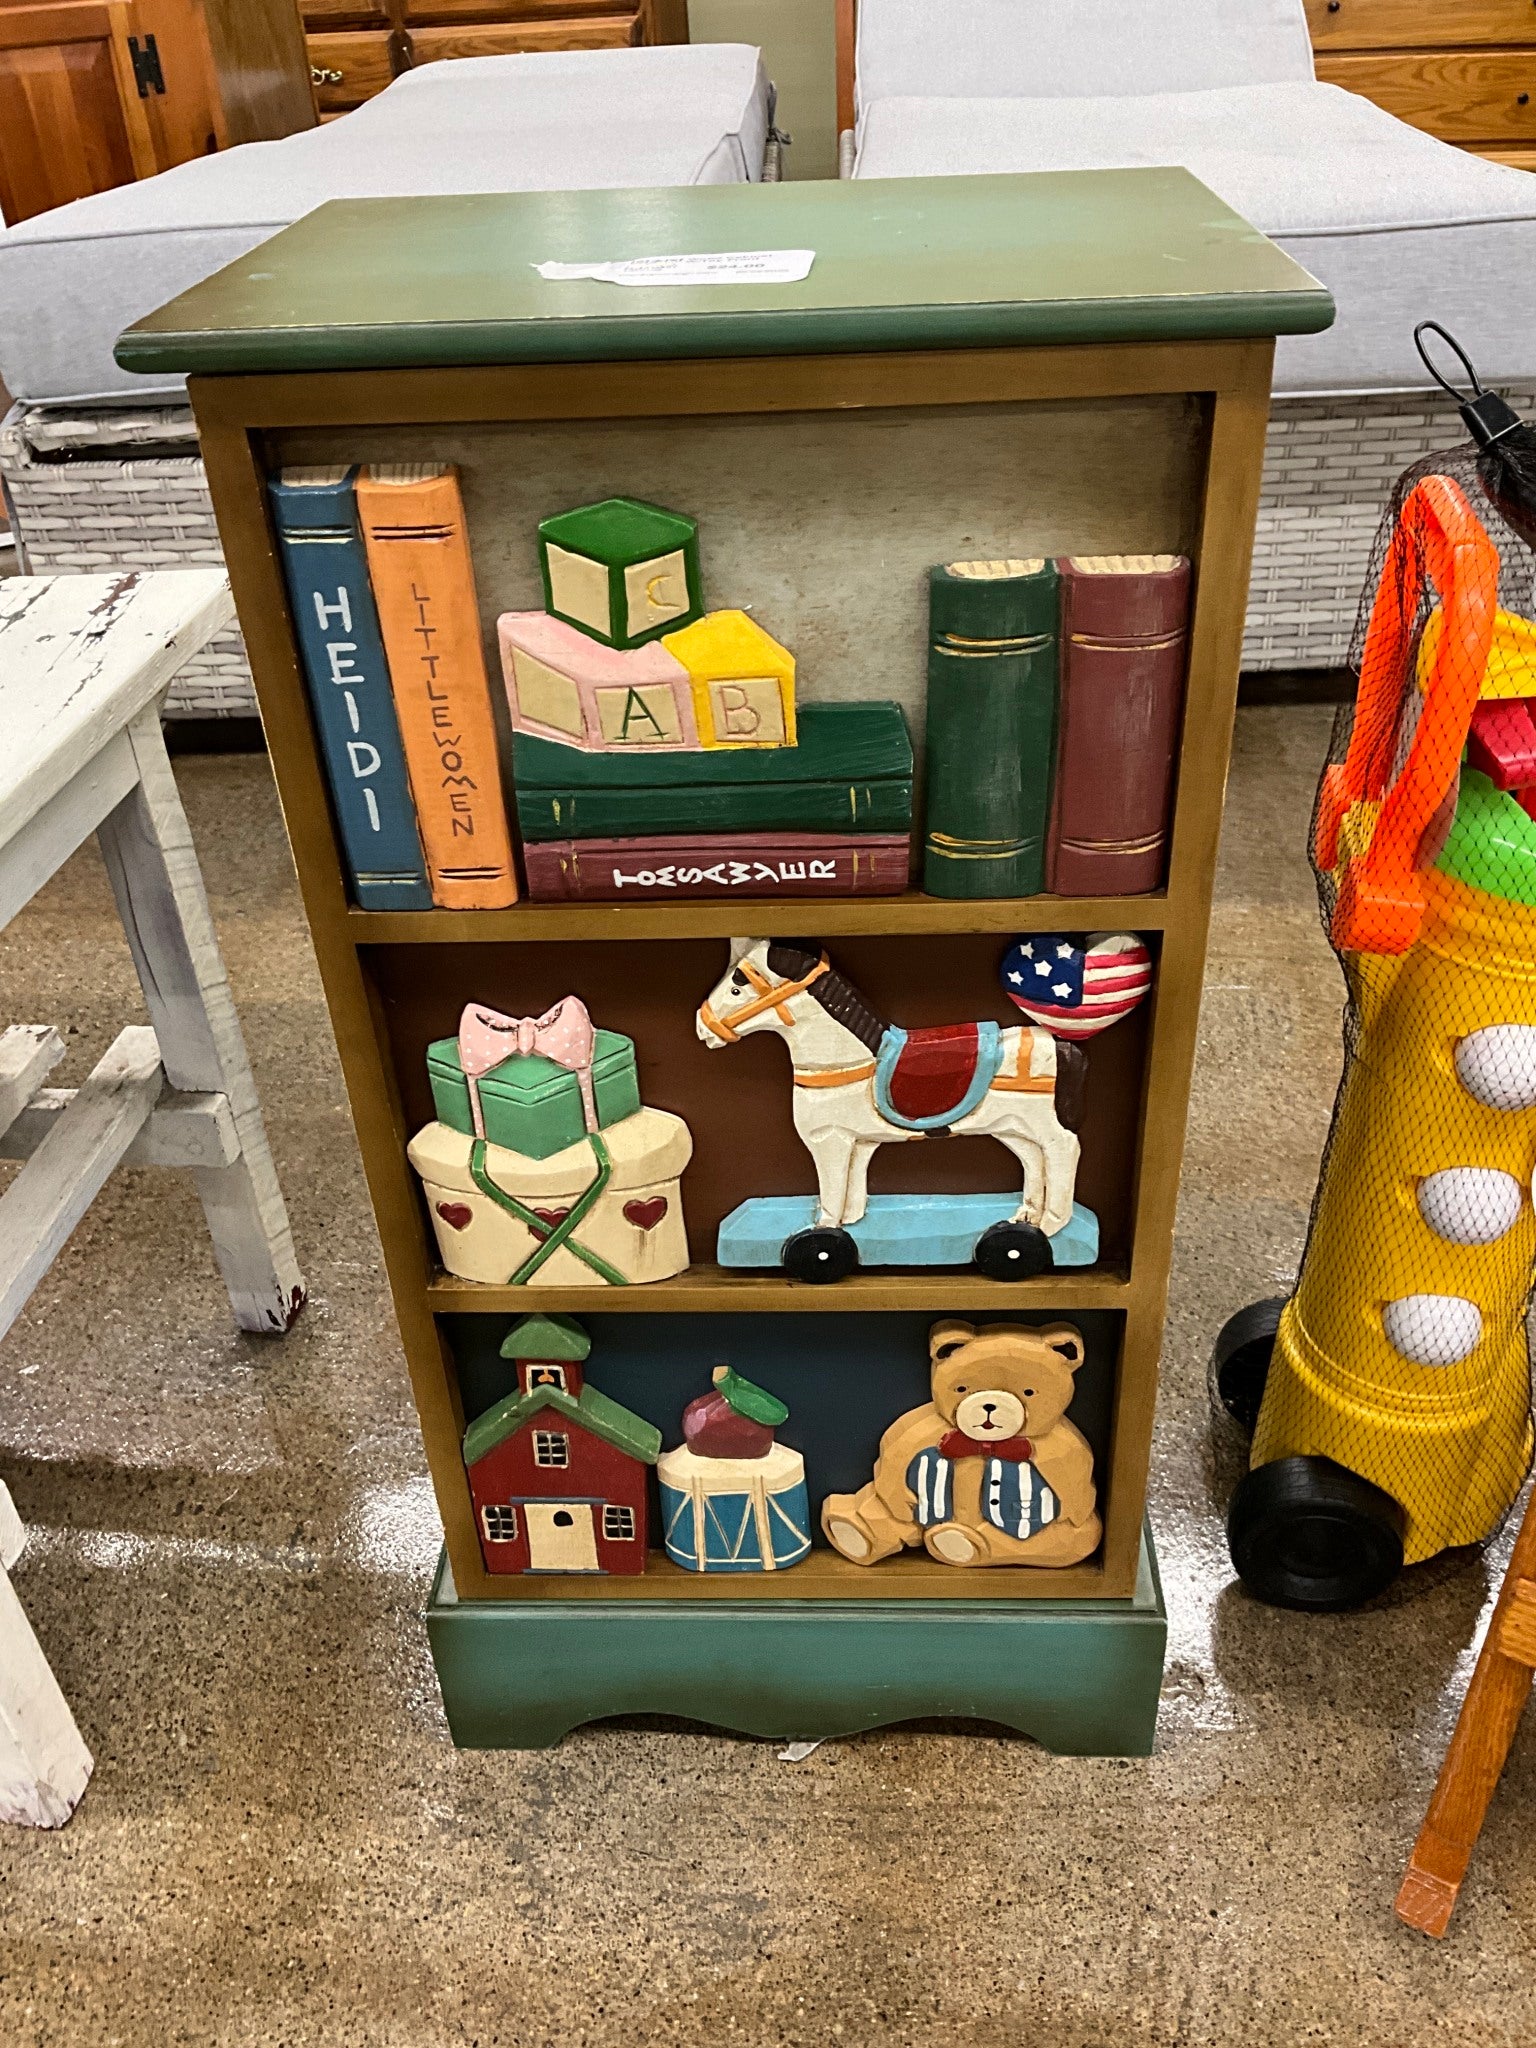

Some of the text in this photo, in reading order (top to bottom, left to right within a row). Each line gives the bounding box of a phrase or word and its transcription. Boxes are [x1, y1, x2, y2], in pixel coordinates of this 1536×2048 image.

[646, 574, 680, 608] C
[312, 585, 381, 832] HEIDI
[614, 686, 668, 740] A
[719, 685, 761, 735] B
